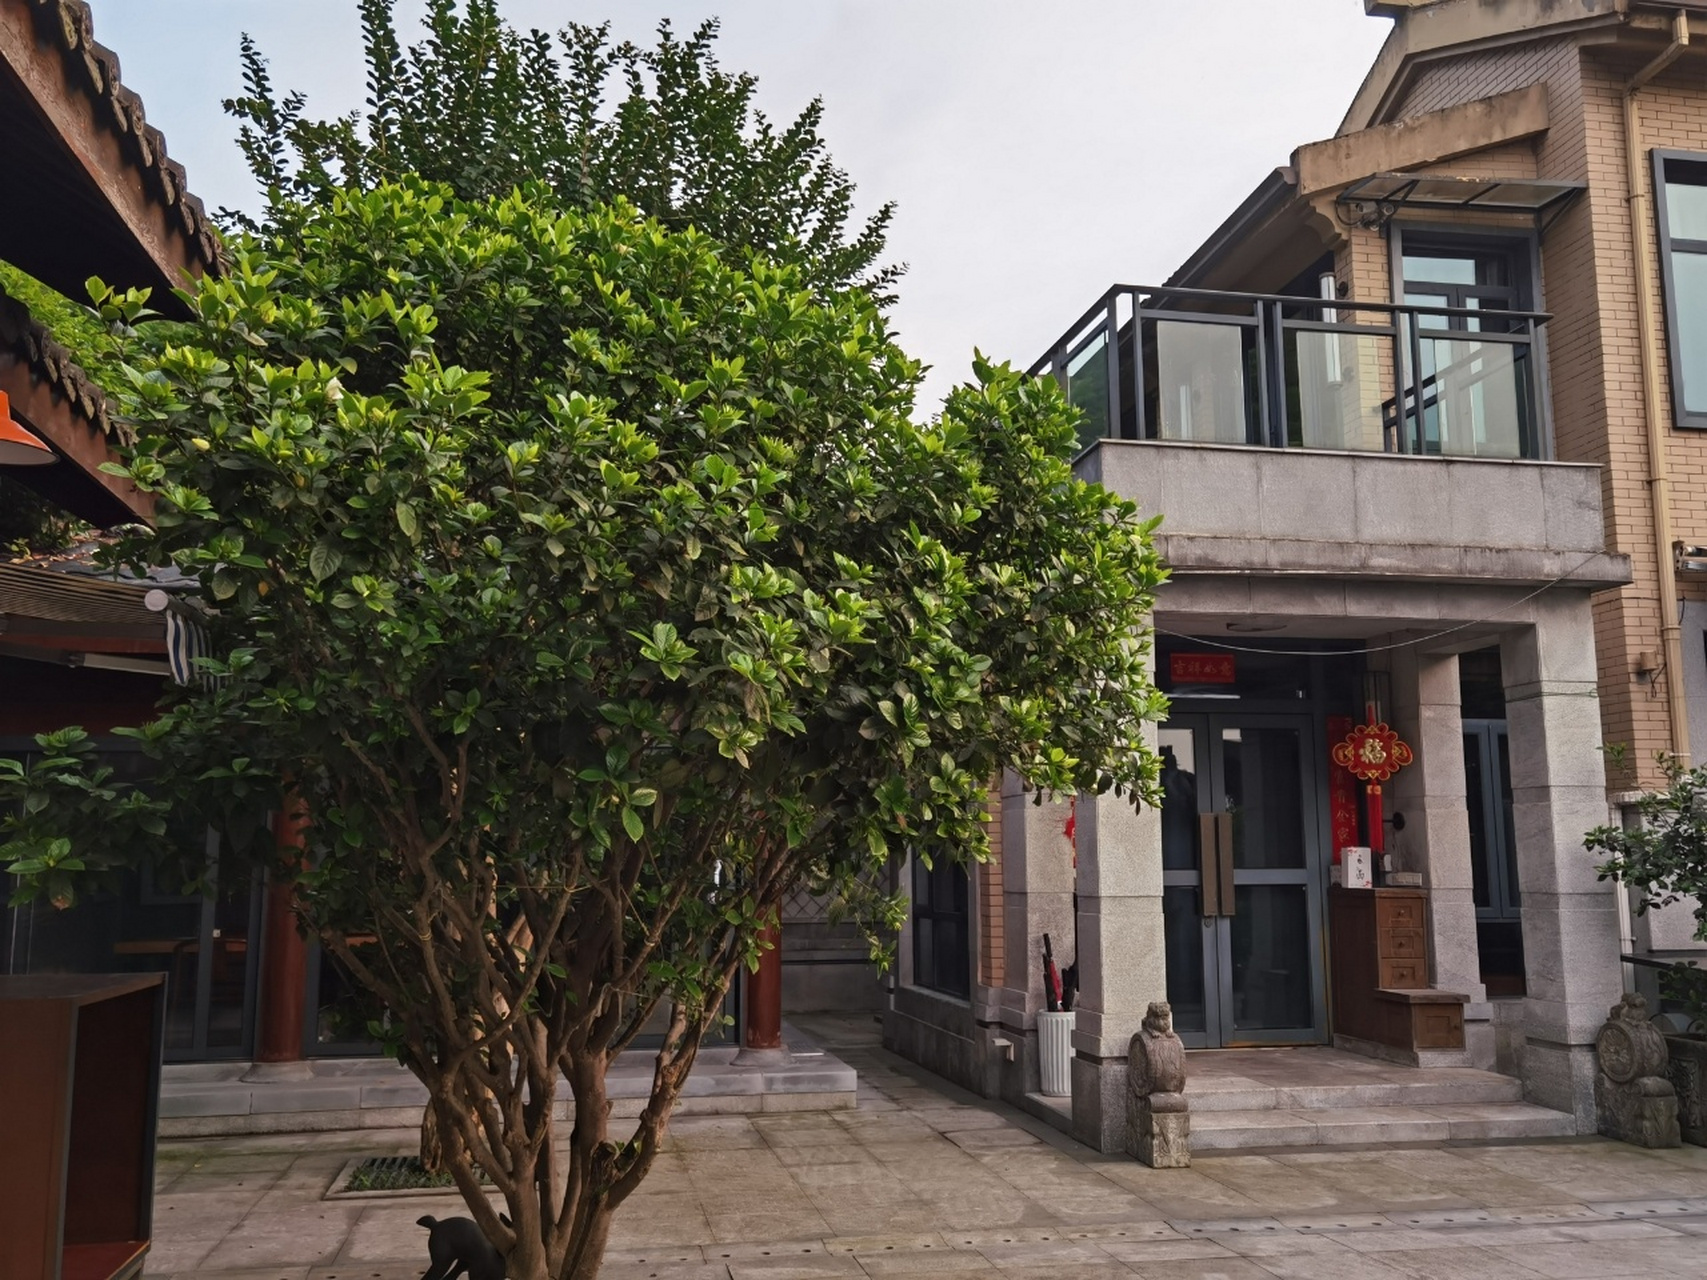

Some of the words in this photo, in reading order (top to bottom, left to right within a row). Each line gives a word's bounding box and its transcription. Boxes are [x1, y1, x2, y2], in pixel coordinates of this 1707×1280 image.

[1173, 660, 1232, 676] 吉祥如意
[1359, 738, 1386, 764] 福
